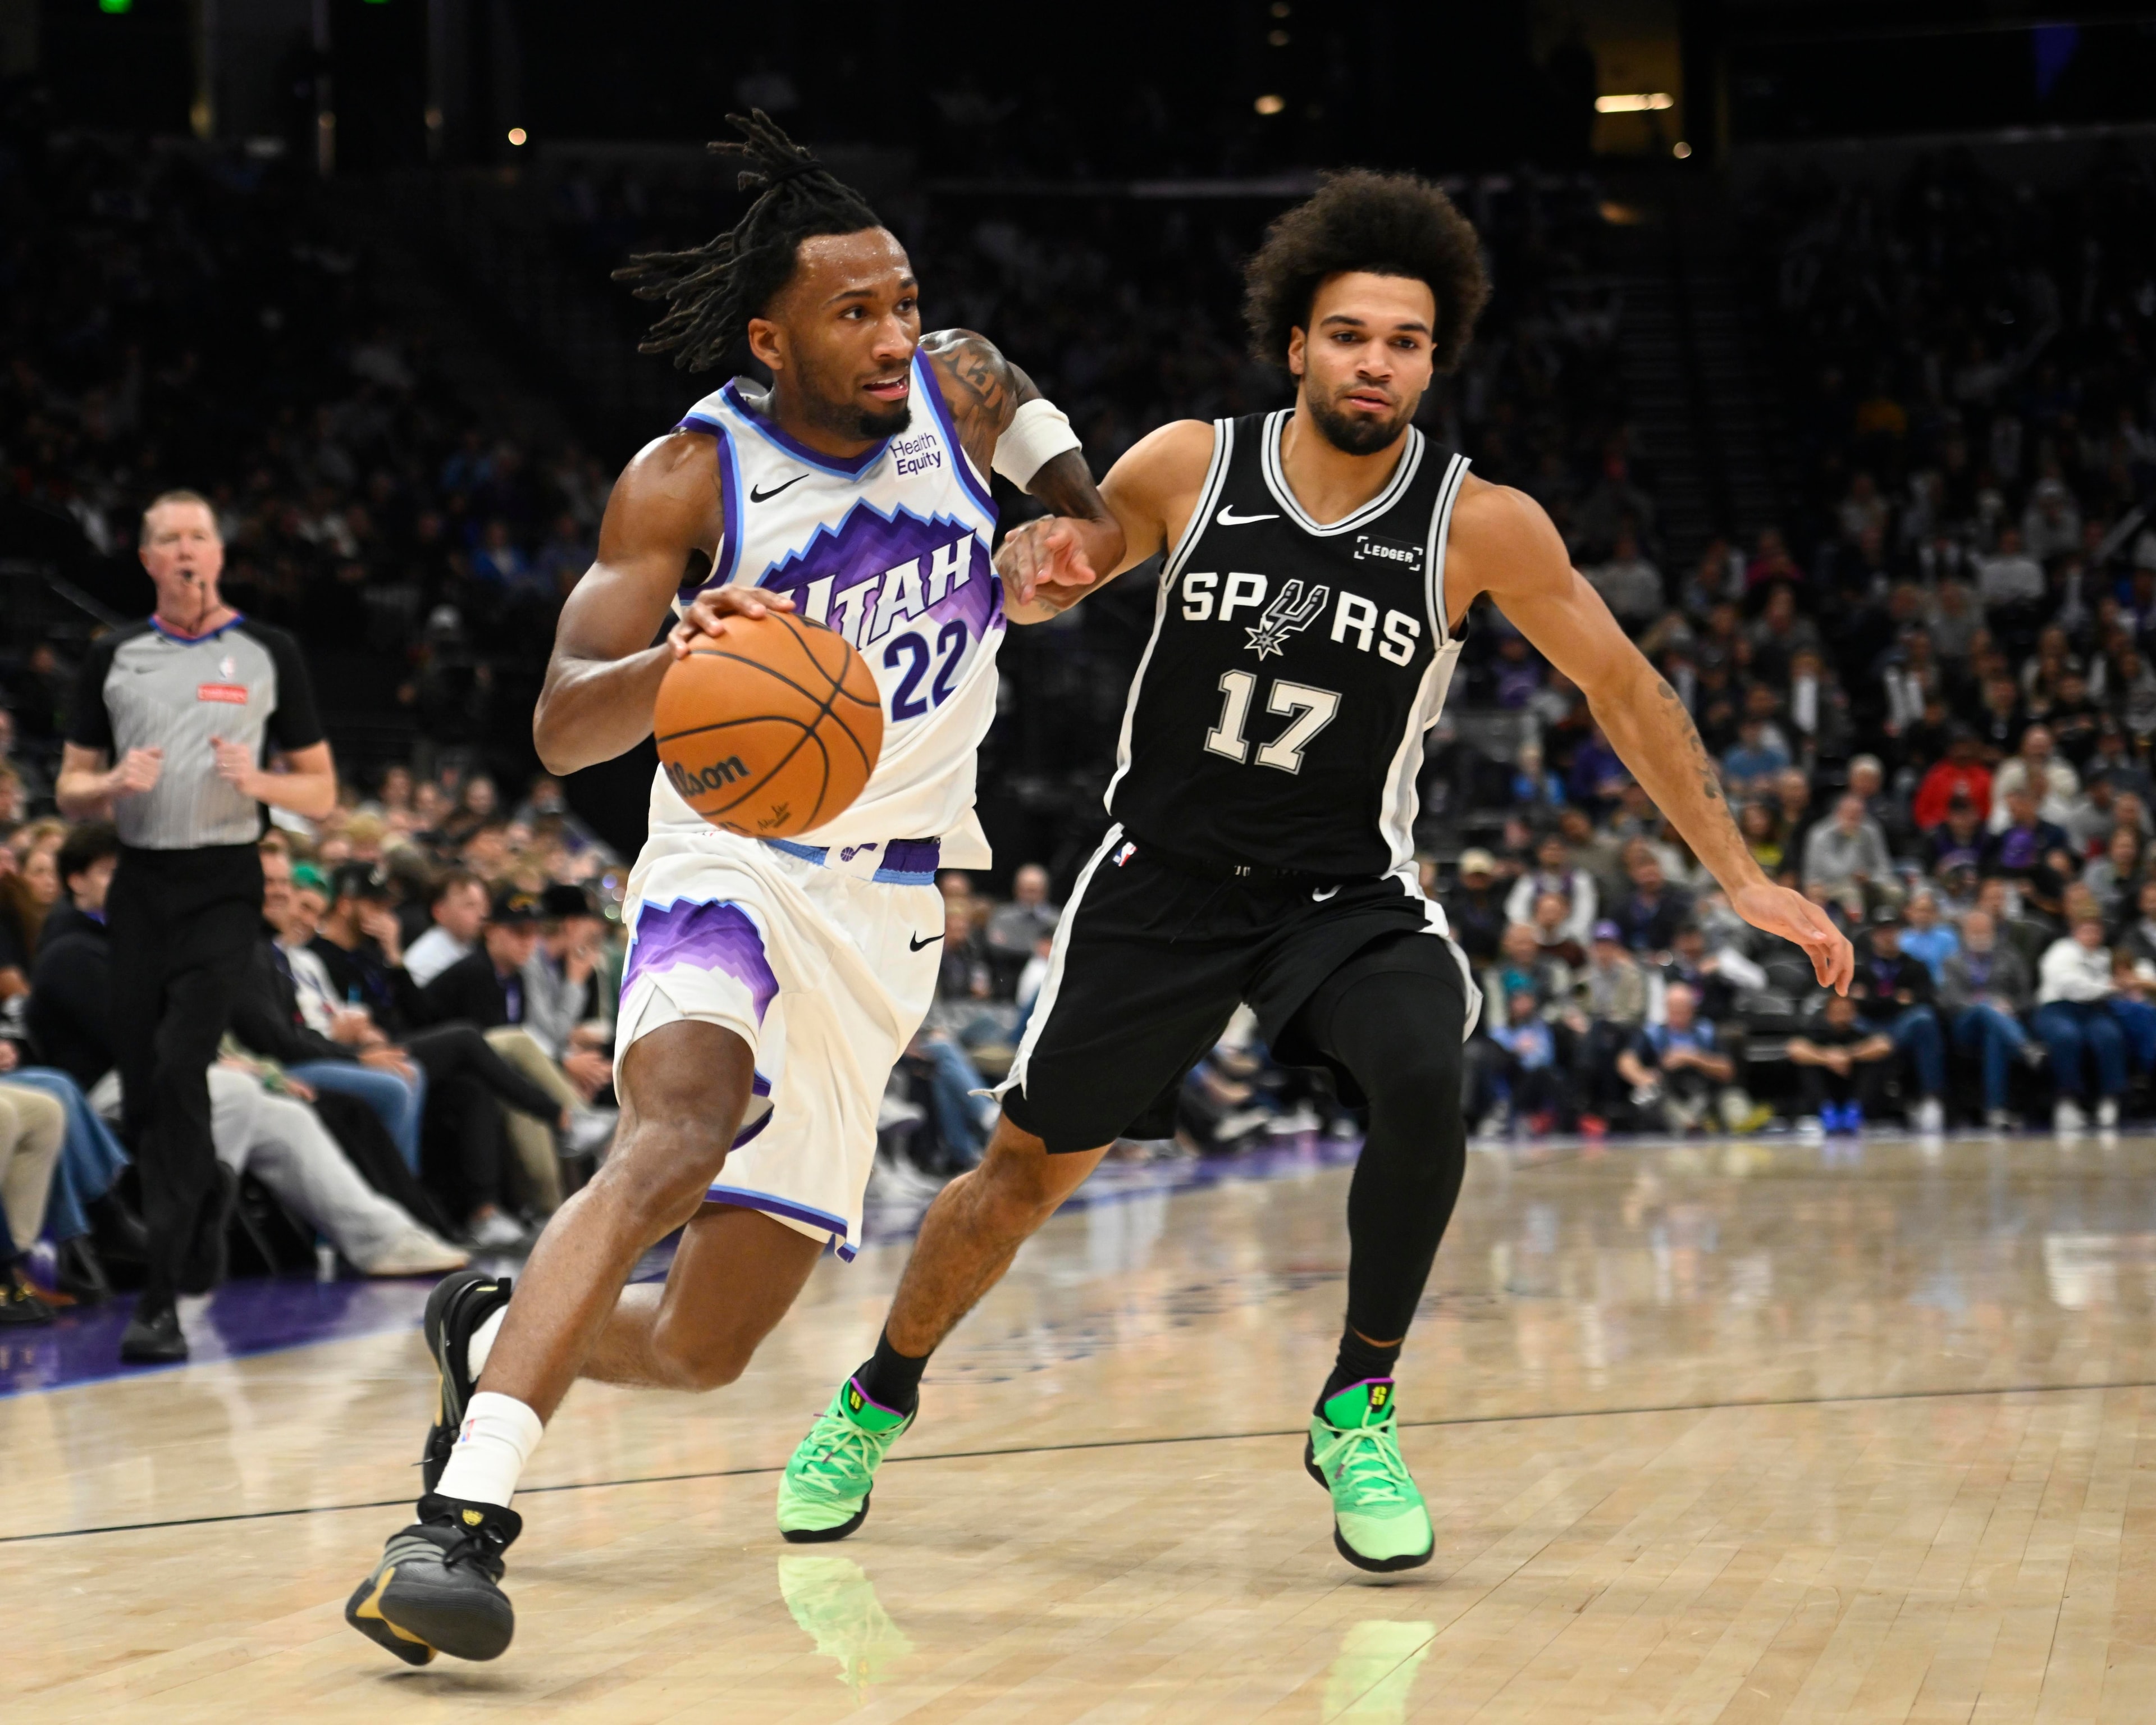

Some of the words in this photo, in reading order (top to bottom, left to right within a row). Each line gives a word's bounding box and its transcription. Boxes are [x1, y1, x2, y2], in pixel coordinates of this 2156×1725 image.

[889, 432, 937, 458] Health
[897, 451, 940, 476] Equity
[1363, 543, 1414, 563] LEDGER
[1182, 572, 1420, 667] SPURS
[883, 618, 968, 723] 22
[1204, 669, 1342, 775] 17
[664, 755, 751, 798] lson
